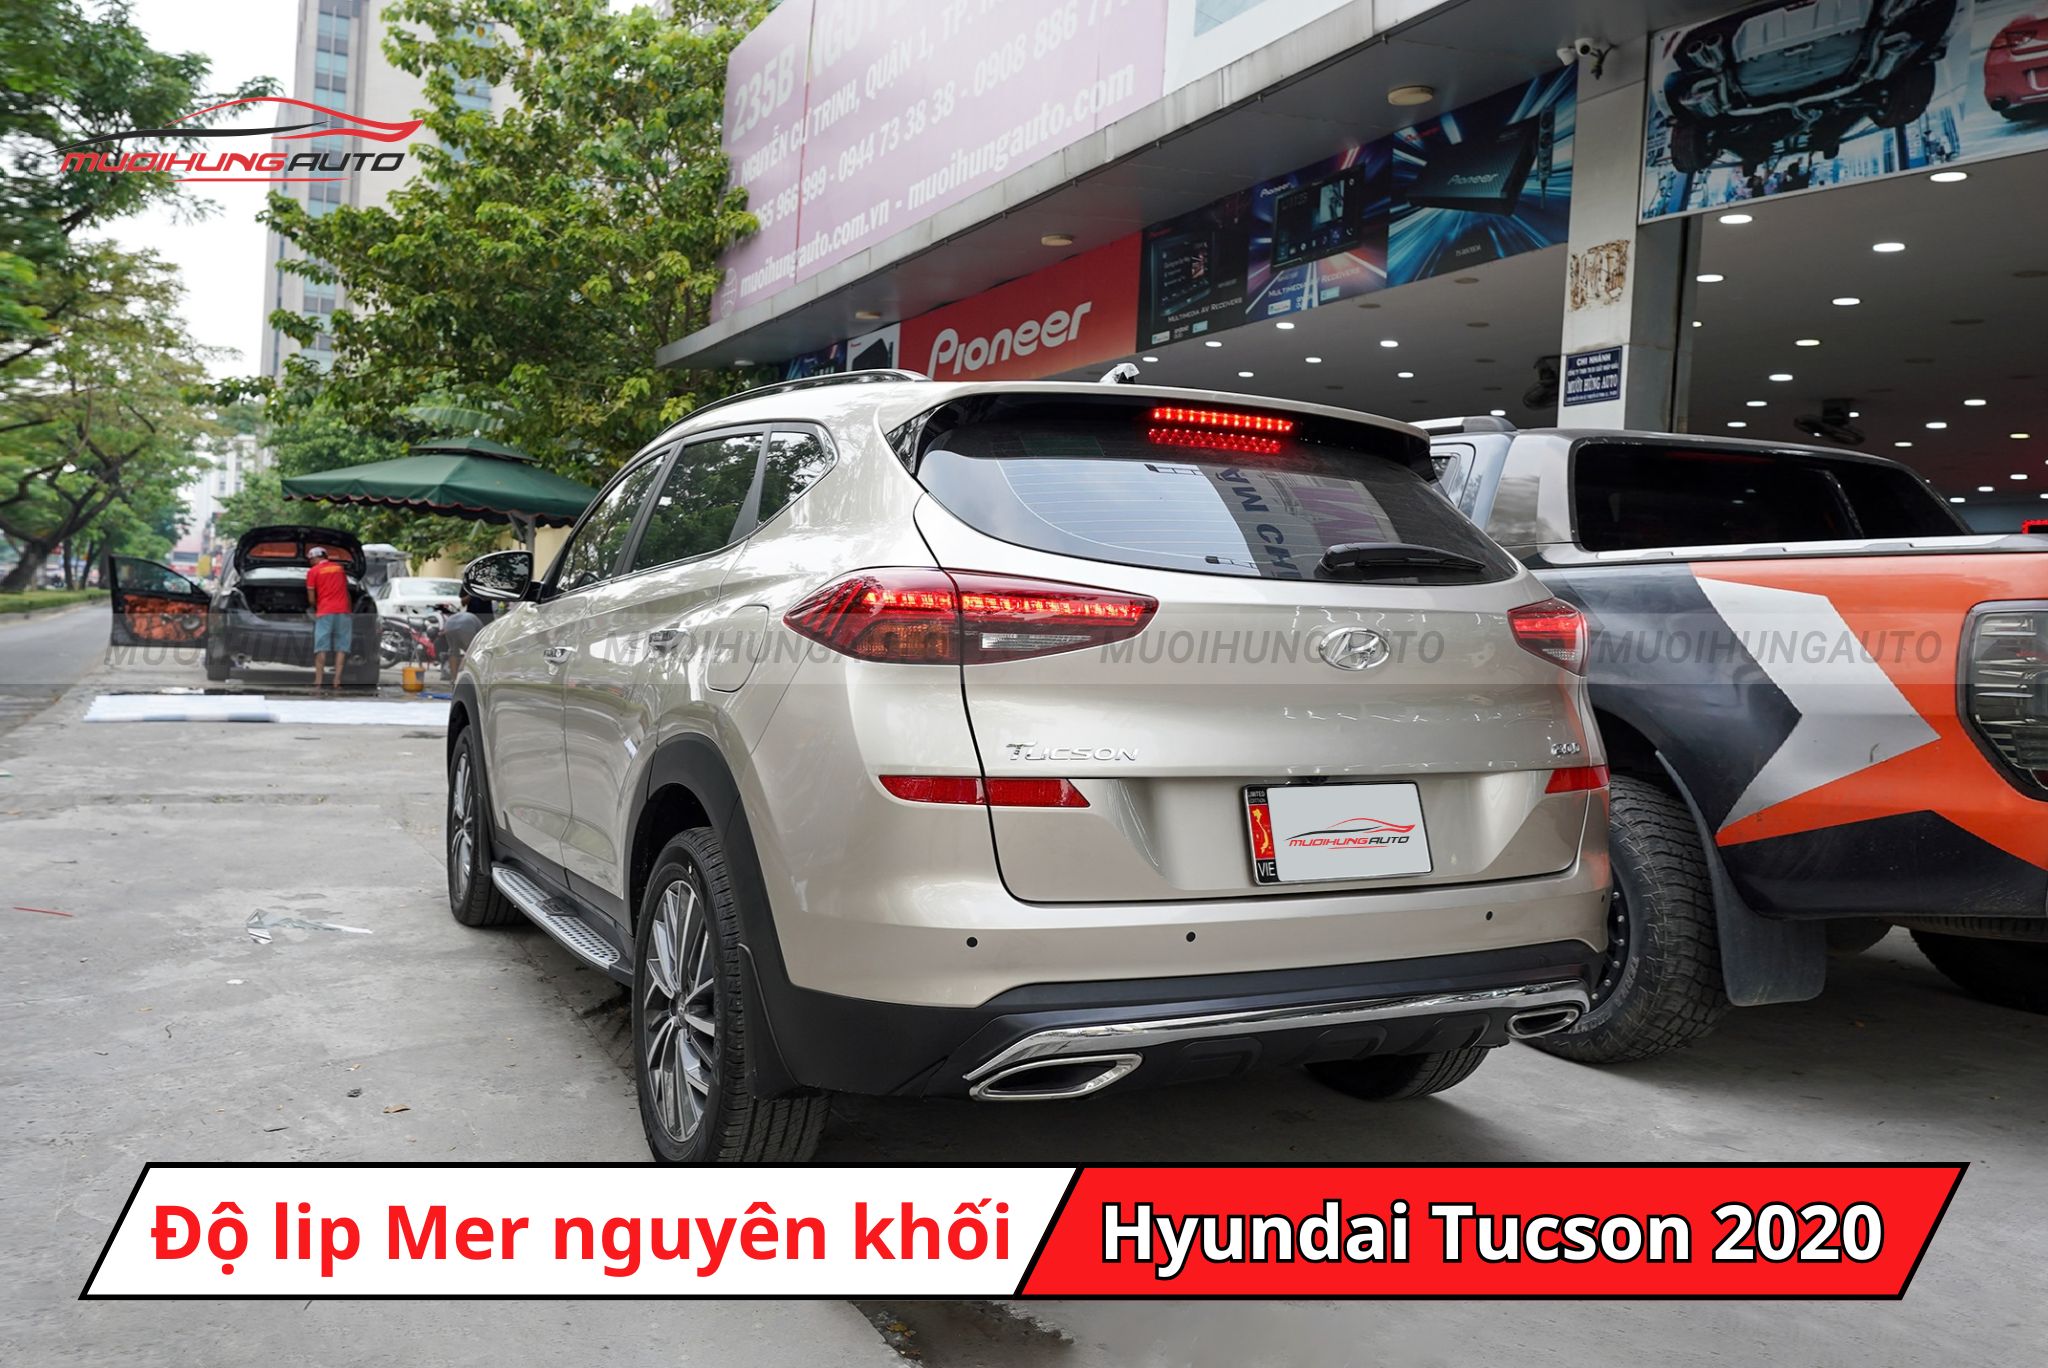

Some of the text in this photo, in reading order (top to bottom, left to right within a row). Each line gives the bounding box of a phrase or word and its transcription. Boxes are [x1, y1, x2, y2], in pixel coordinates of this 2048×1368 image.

[731, 44, 796, 144] 235B
[776, 183, 799, 221] 966
[802, 165, 827, 206] 999
[838, 132, 875, 183] 0944
[880, 116, 900, 157] 73
[904, 98, 927, 141] 38
[931, 79, 956, 125] 38
[973, 33, 1027, 97] 0908
[1033, 0, 1078, 60] 886
[813, 79, 861, 137] TRINH,
[740, 199, 890, 298] muoihungauto.com.vn
[907, 63, 1135, 211] muoihungauto.com
[928, 301, 1093, 380] Pioneer
[1258, 862, 1276, 877] VIE
